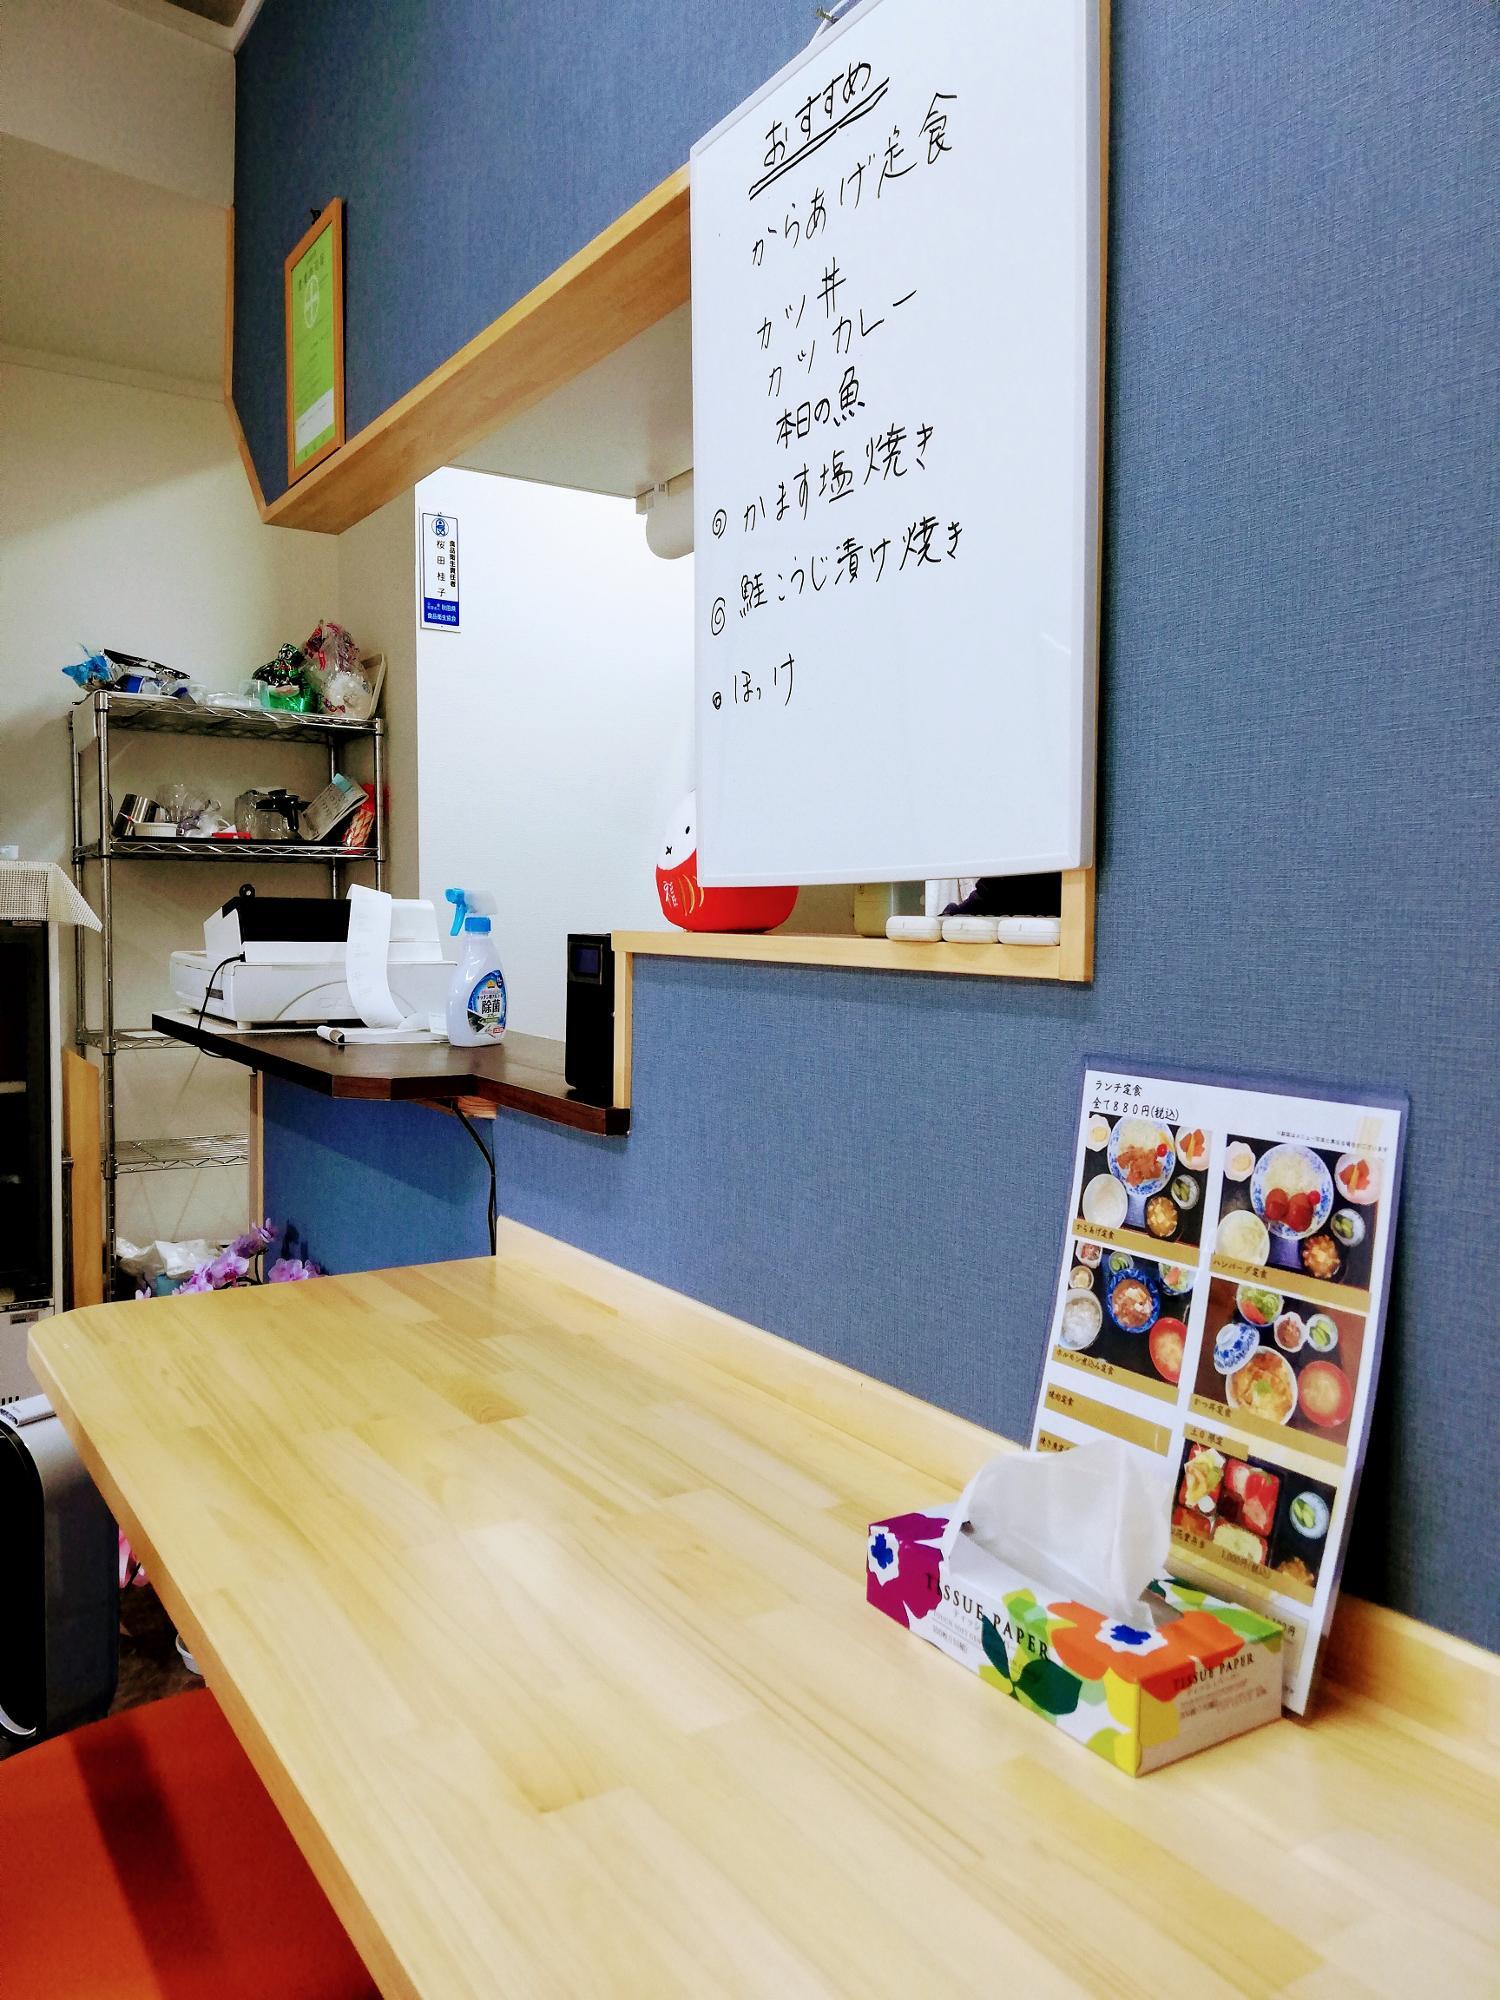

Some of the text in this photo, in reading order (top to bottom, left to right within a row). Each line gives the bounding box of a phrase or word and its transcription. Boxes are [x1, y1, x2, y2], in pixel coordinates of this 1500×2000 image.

[764, 62, 871, 167] おすすめ
[752, 92, 957, 266] からあげ定食
[768, 289, 917, 397] カツカレー
[776, 365, 865, 449] 本日の魚
[743, 422, 934, 532] かます塩焼き
[739, 515, 963, 618] 鮭こうじ漬け焼き
[734, 653, 795, 706] ほっけ
[481, 999, 500, 1014] 除菌
[1095, 1080, 1142, 1097] ランチ定食
[926, 1572, 984, 1621] TISSUE
[993, 1612, 1049, 1661] PAPER
[1173, 1669, 1214, 1692] TISSUE
[1219, 1652, 1255, 1675] PAPER
